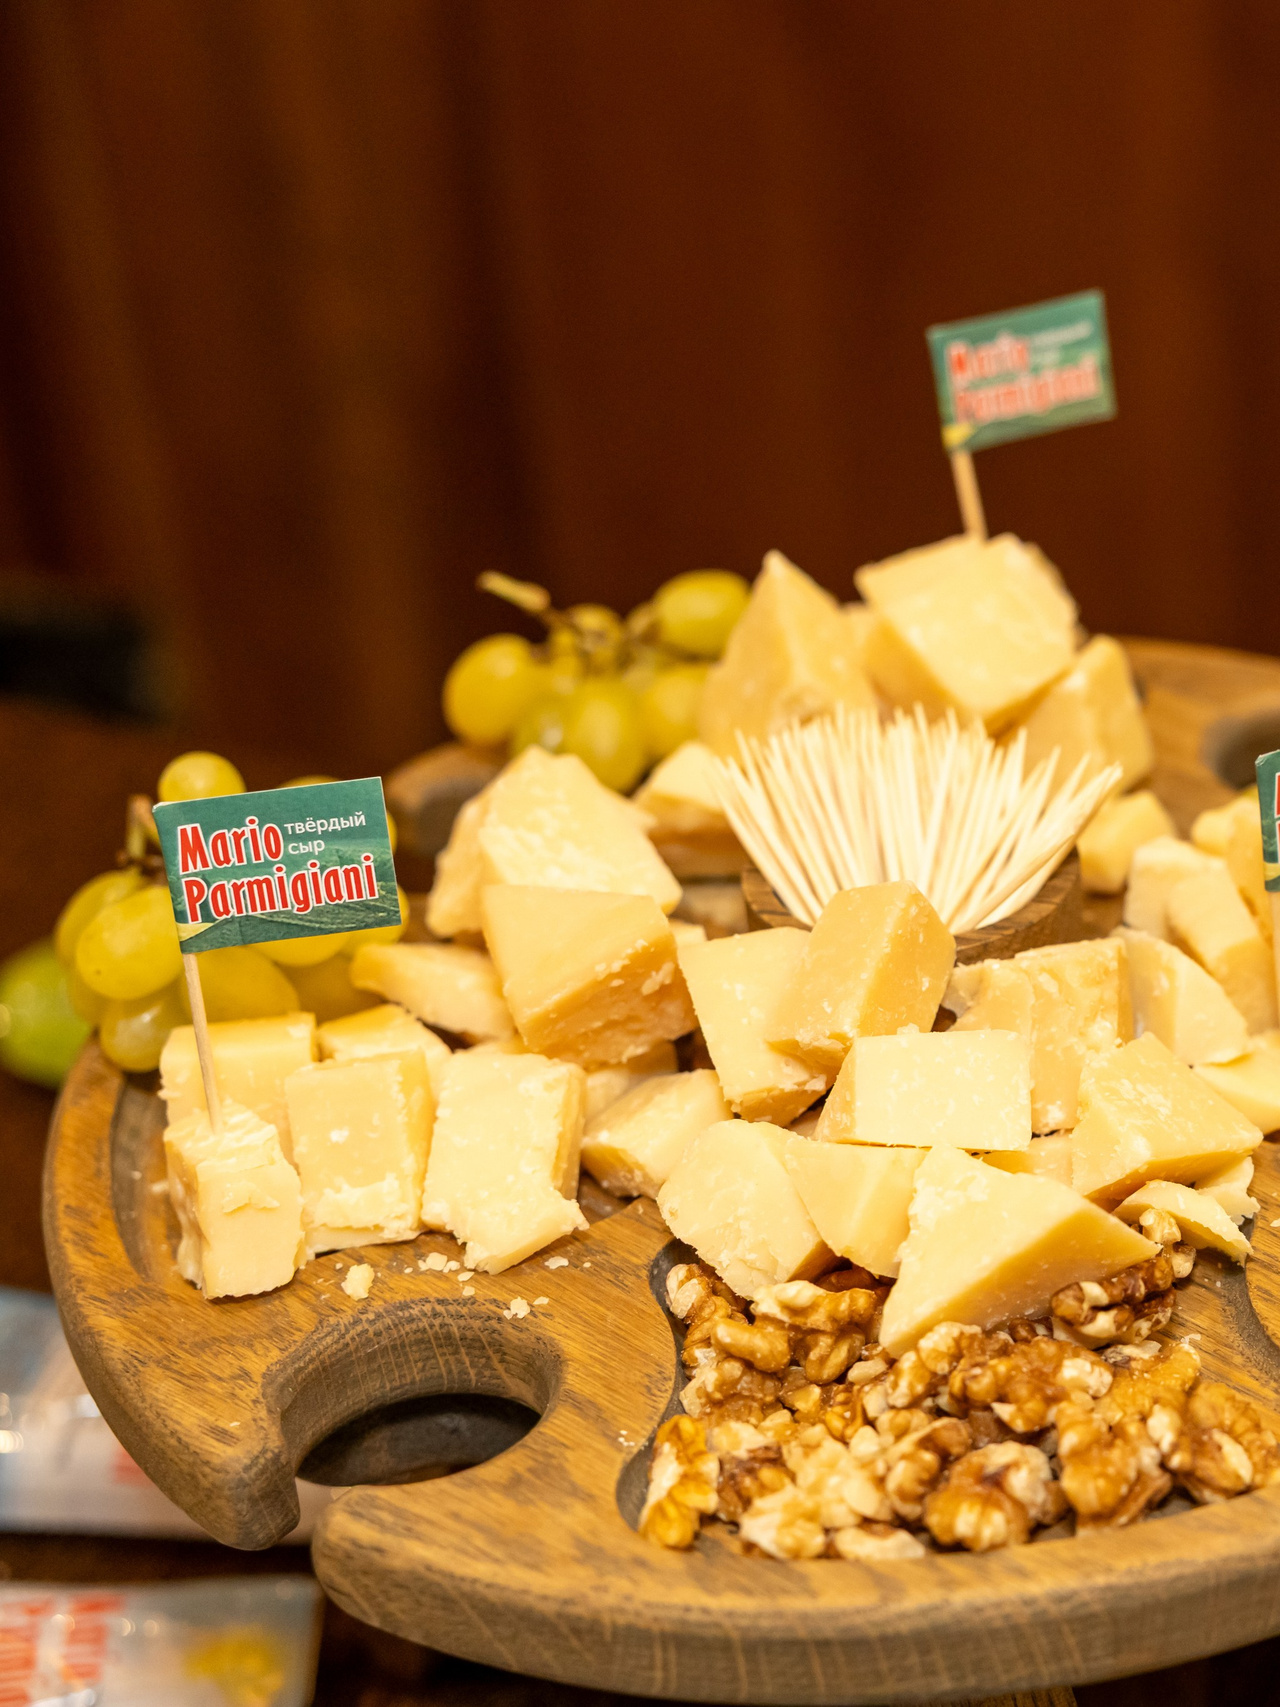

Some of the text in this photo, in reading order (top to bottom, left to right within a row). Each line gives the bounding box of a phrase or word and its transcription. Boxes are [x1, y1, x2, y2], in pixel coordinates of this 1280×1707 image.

[284, 811, 366, 836] твёрдый
[177, 815, 285, 875] Mario
[288, 838, 326, 857] сыр
[181, 852, 379, 924] Parmigiani
